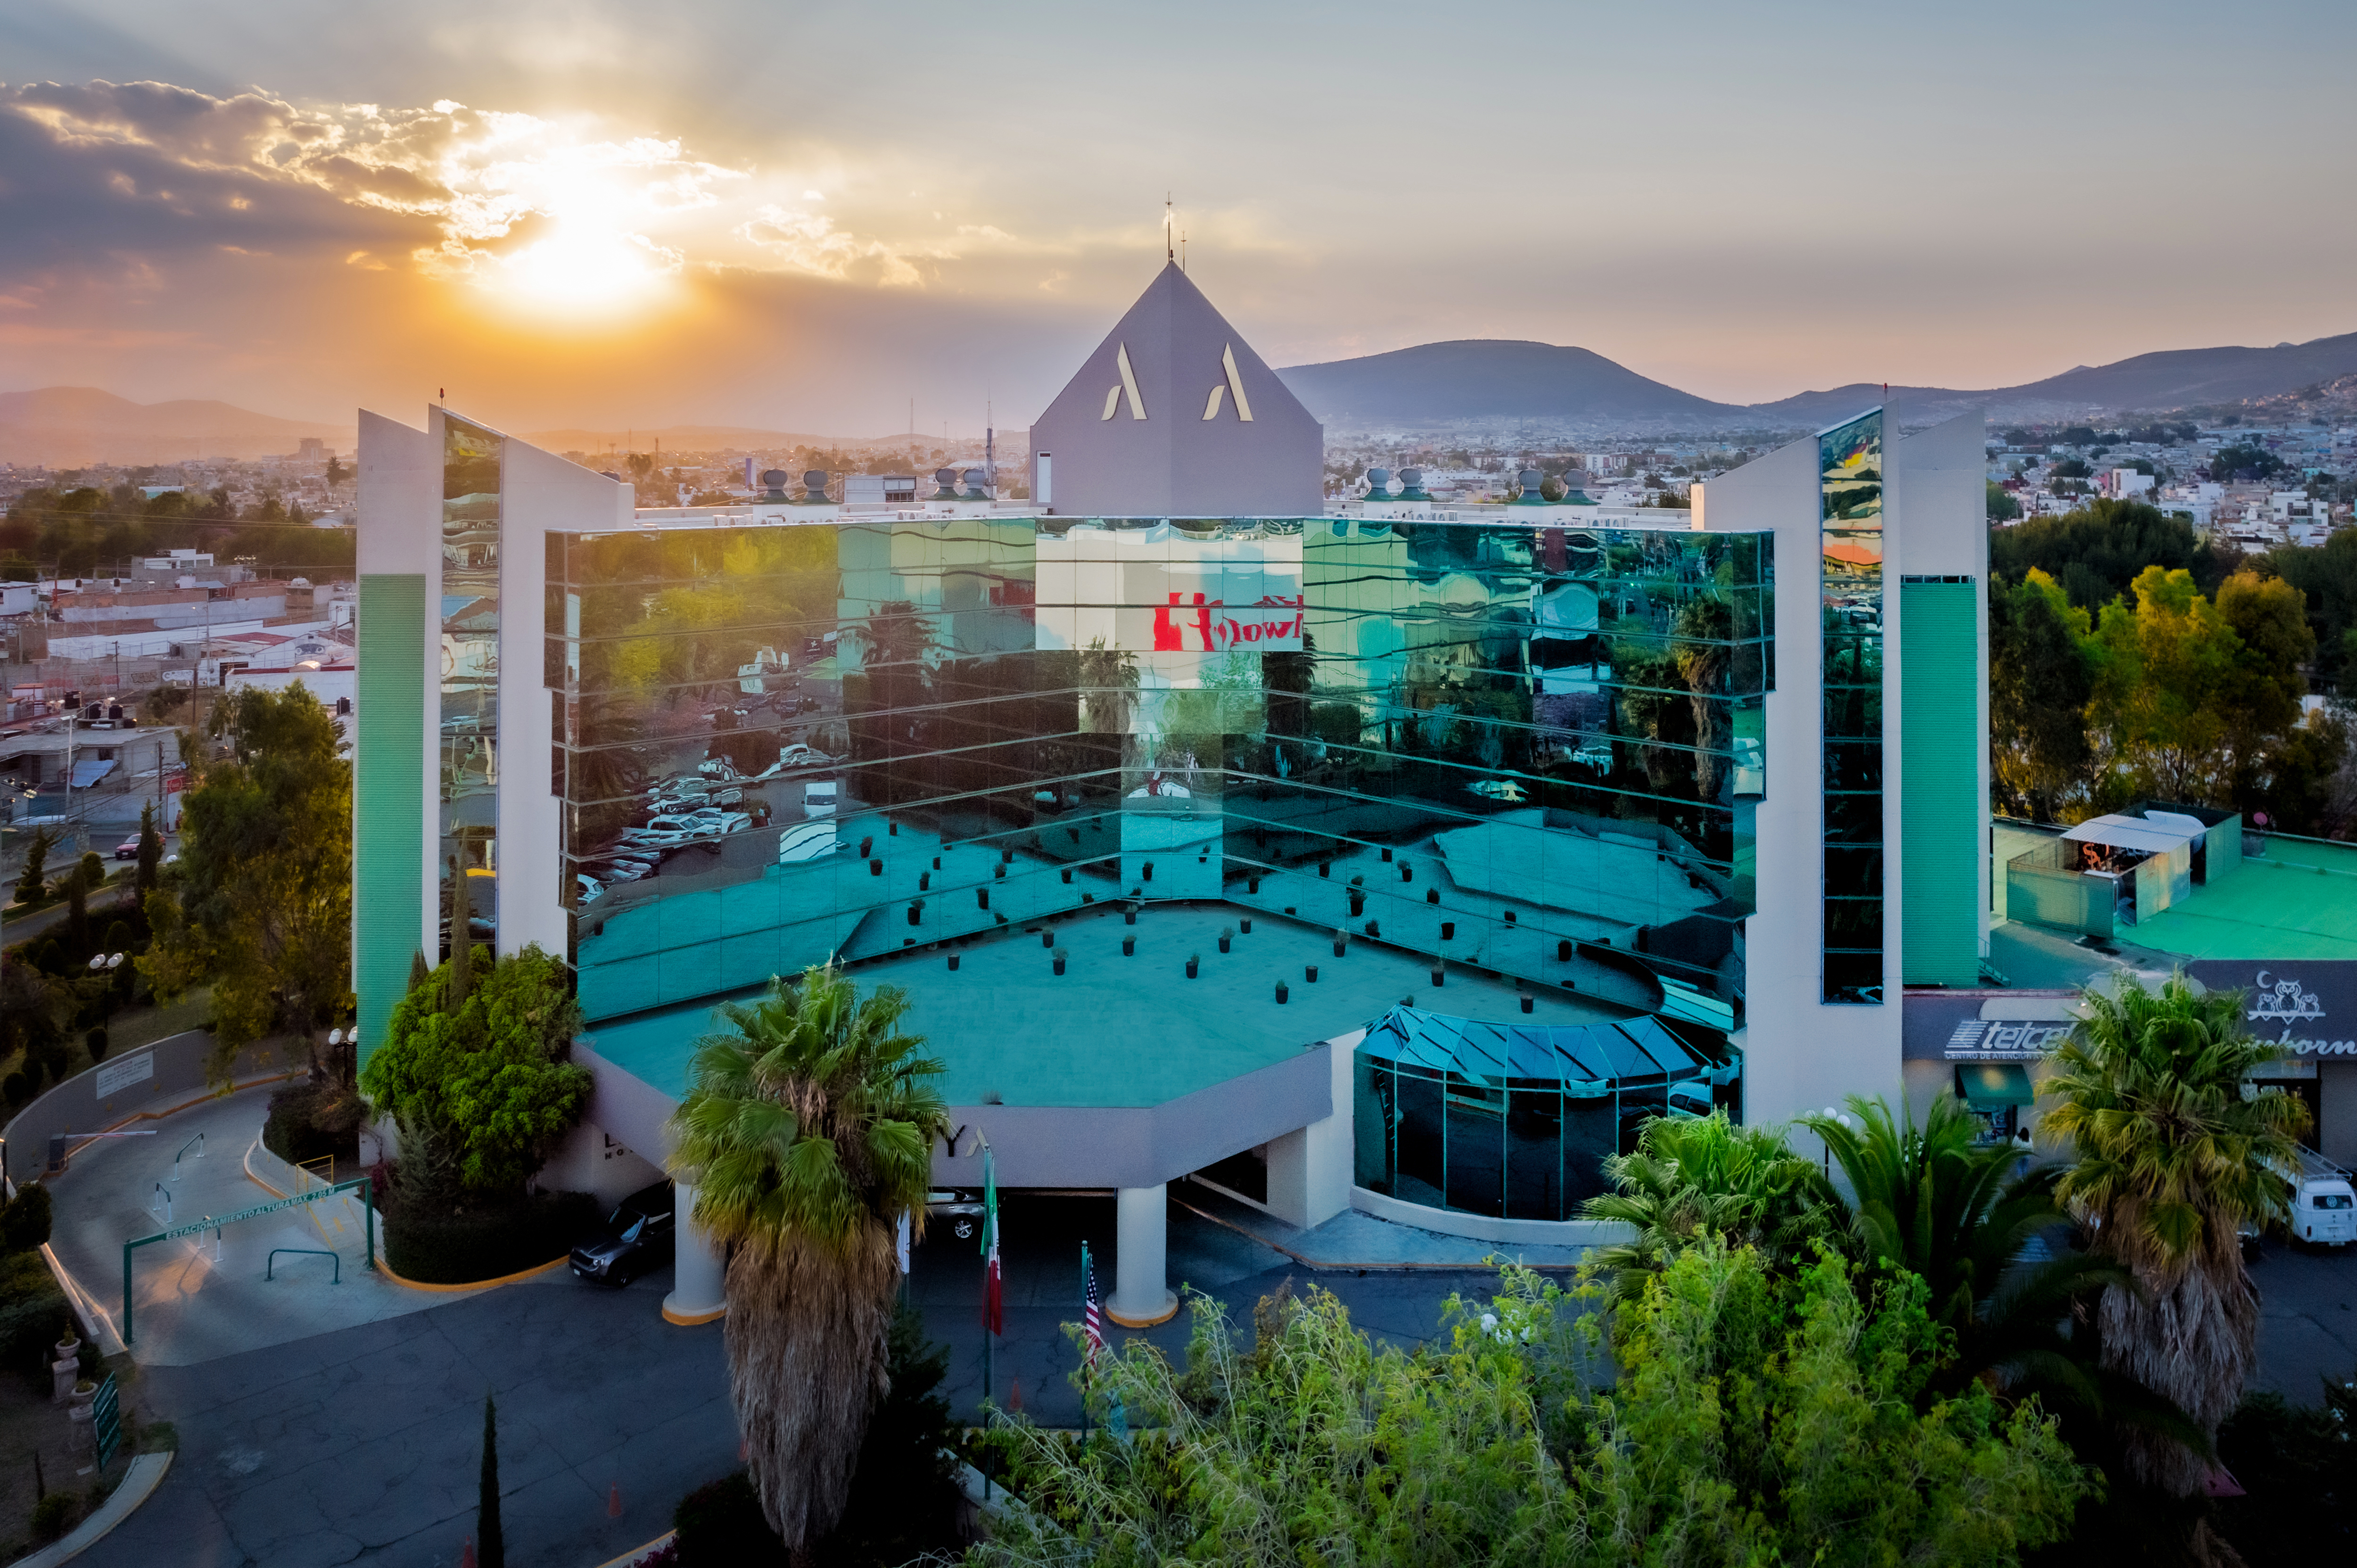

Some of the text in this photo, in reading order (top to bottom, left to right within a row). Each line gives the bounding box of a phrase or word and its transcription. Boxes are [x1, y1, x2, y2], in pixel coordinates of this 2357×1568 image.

[1981, 1021, 2078, 1049] telcel
[166, 1210, 255, 1240] ESTACIONAMIENTO
[255, 1200, 290, 1215] ALTURA
[312, 1190, 327, 1200] 2.05
